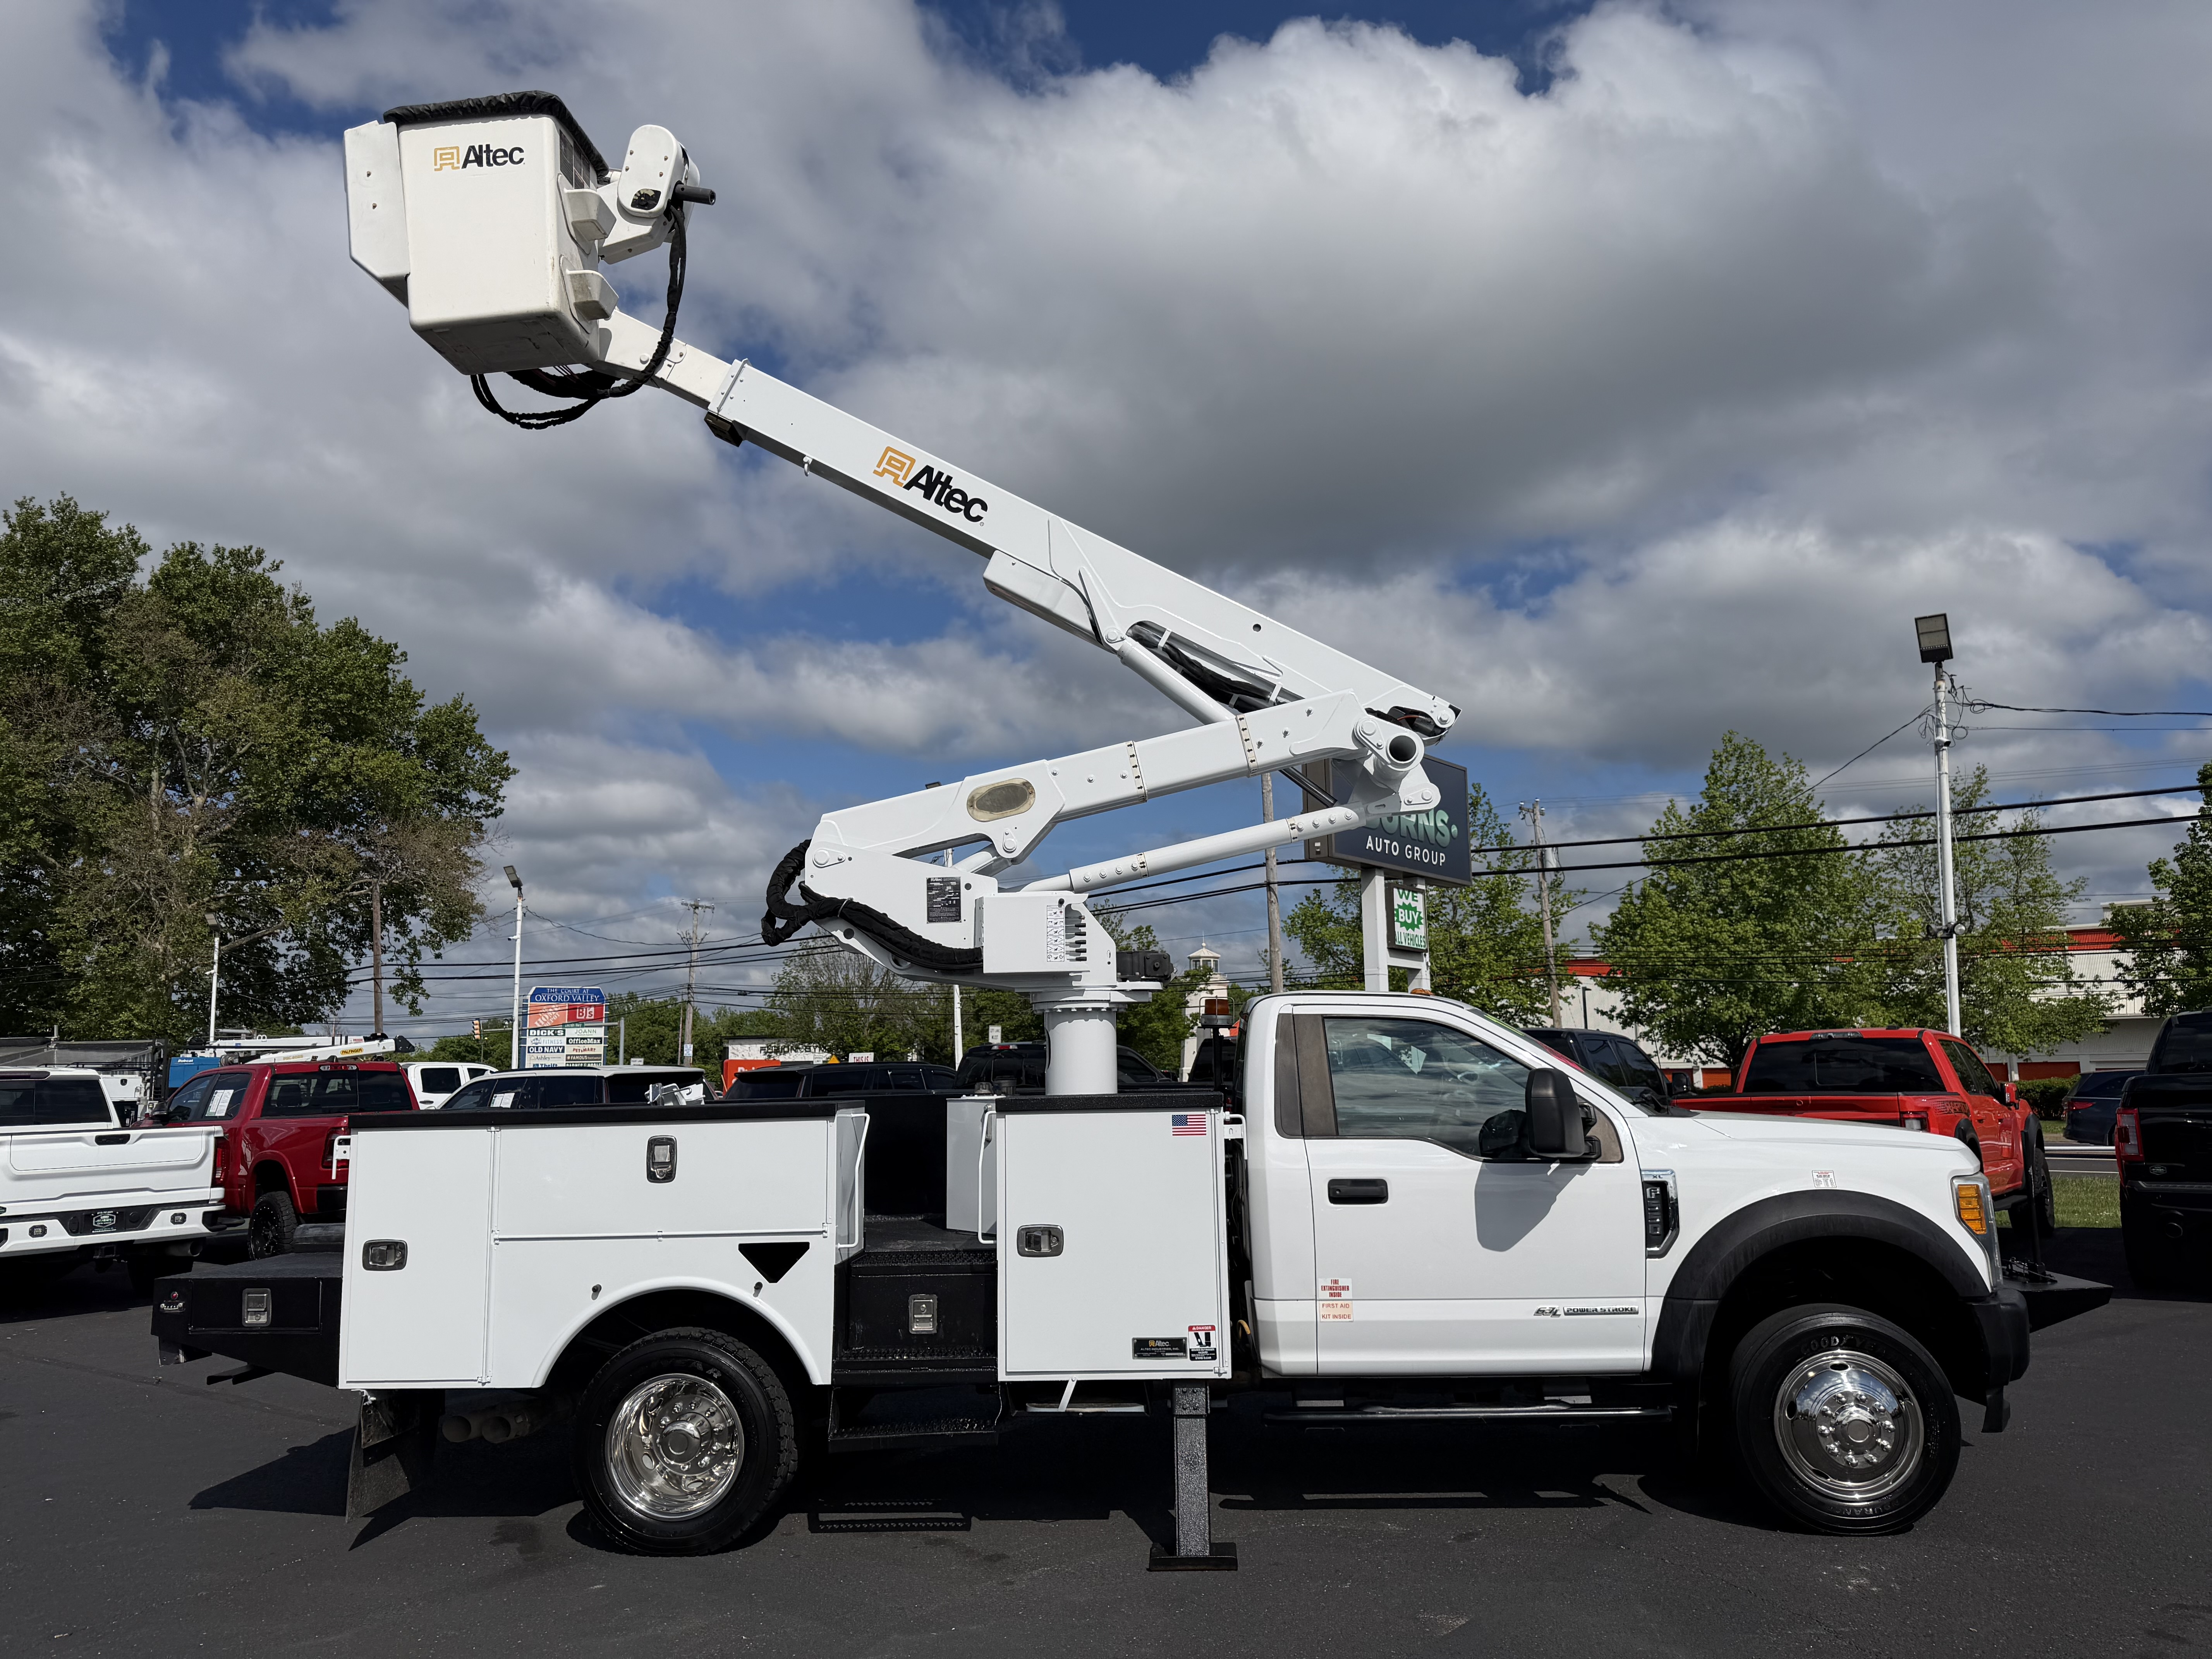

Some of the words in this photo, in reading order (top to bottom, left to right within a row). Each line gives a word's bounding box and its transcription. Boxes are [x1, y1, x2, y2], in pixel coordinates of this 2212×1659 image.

[462, 144, 524, 169] Altec
[903, 465, 988, 522] Altec
[1366, 835, 1399, 856] AUTO
[1405, 845, 1446, 866] GROUP
[1397, 888, 1419, 903] WE
[1398, 908, 1419, 925] BUY
[1403, 932, 1426, 948] VEHICLES
